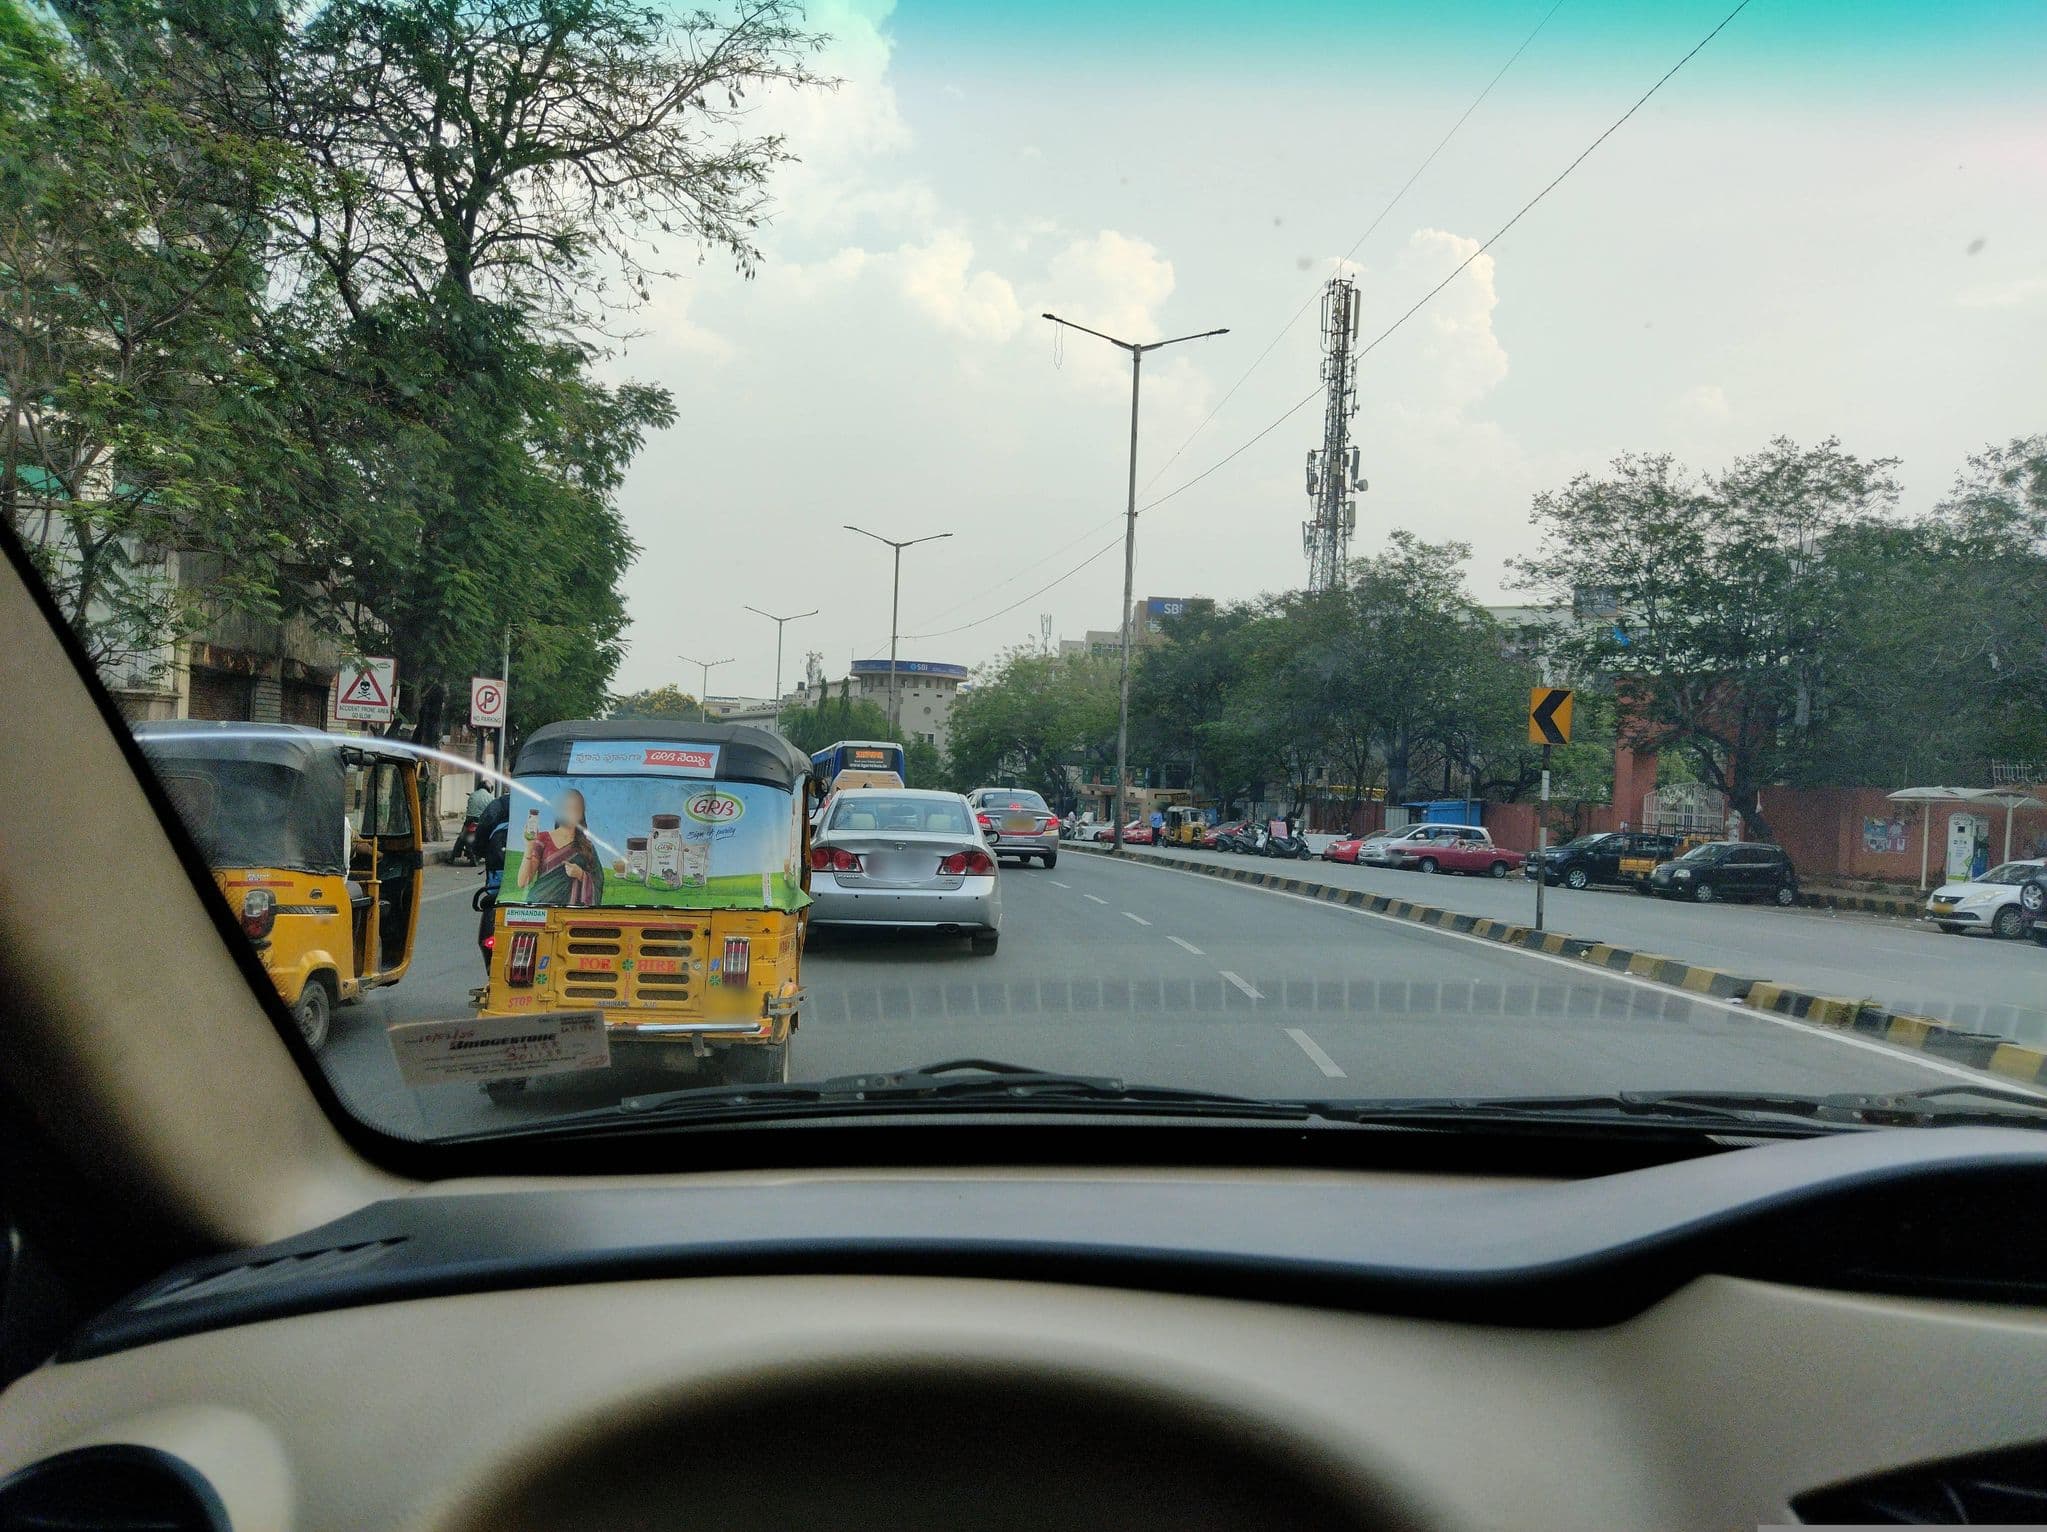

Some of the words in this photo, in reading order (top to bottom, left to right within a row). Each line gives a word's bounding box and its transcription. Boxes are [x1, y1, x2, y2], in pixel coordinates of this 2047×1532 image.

[650, 751, 676, 761] GRB
[693, 799, 735, 817] GRB
[579, 958, 612, 971] FOR
[636, 959, 676, 972] HIRE
[507, 996, 533, 1008] STOP
